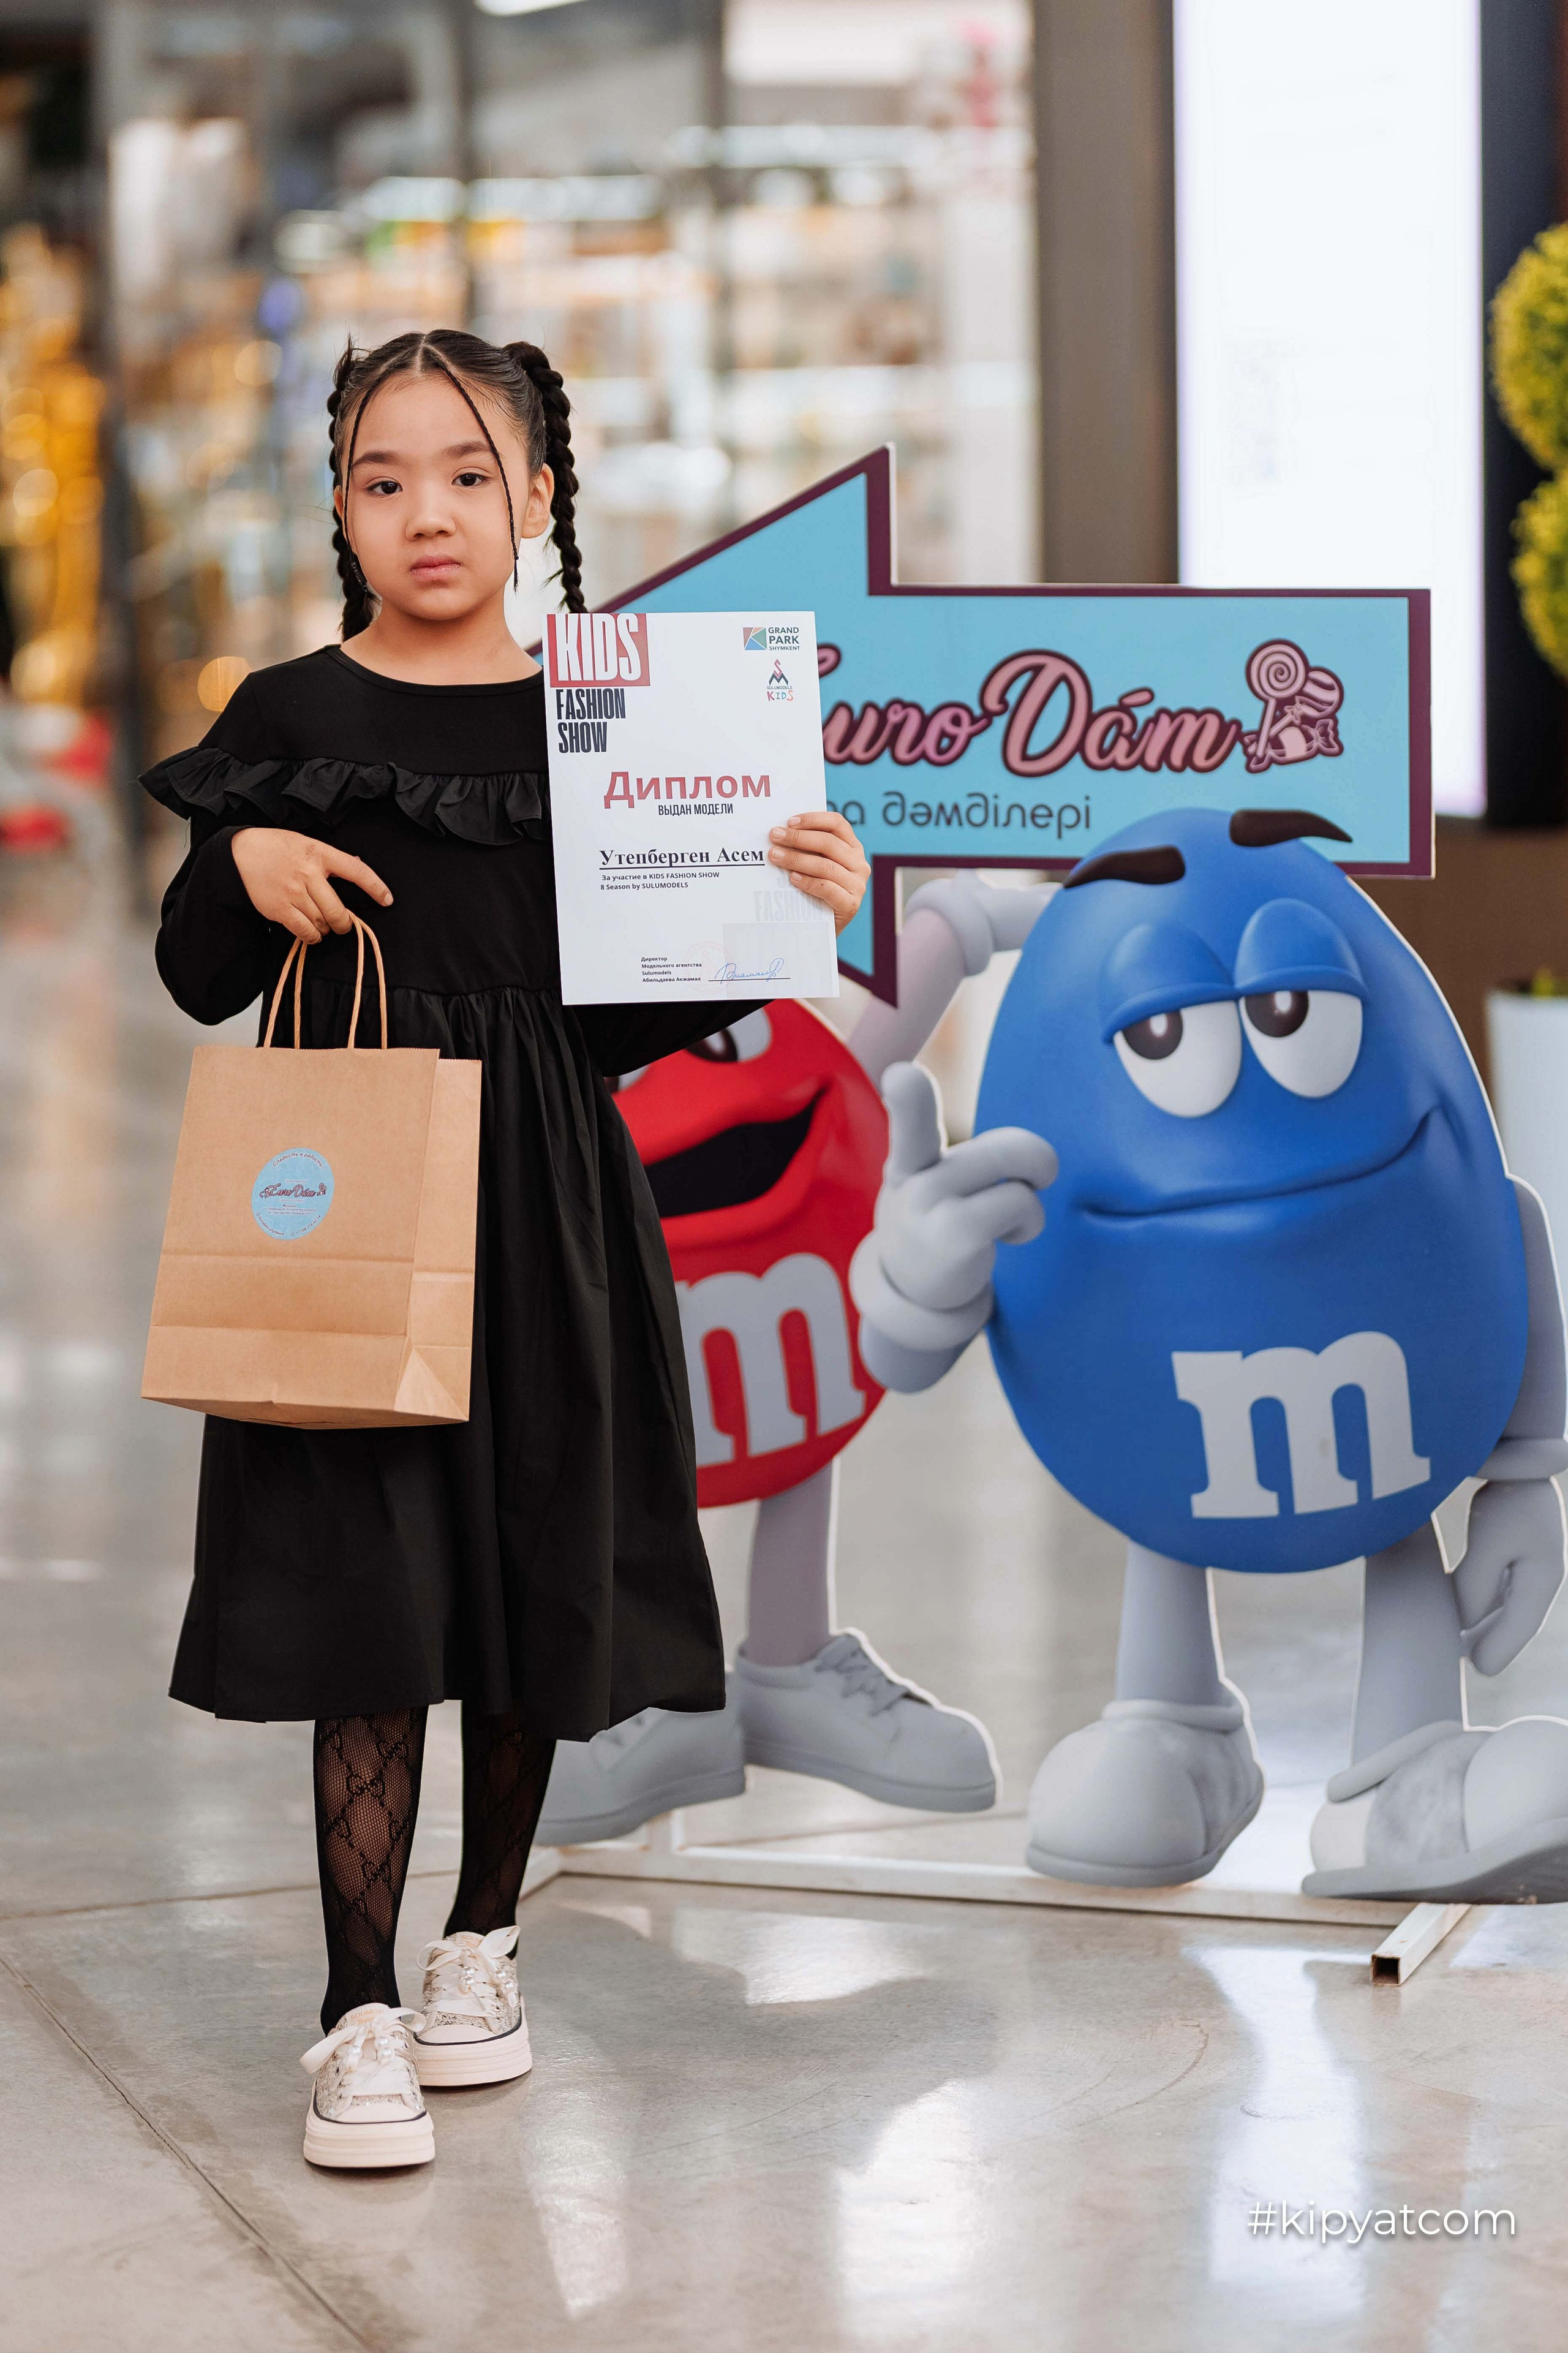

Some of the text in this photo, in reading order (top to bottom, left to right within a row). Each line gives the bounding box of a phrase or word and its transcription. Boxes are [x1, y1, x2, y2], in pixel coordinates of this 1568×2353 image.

[554, 613, 641, 681] KIDS
[769, 635, 799, 644] PARK
[556, 688, 626, 720] FASHION
[767, 690, 794, 701] KIDS
[558, 722, 608, 753] SHOW
[603, 771, 771, 809] Диплом
[658, 803, 734, 816] ВЫДАН МОДЕЛИ
[599, 847, 764, 867] Утепберген Асем
[273, 1152, 299, 1166] Сладость
[676, 1253, 865, 1467] m
[1172, 1331, 1431, 1519] m
